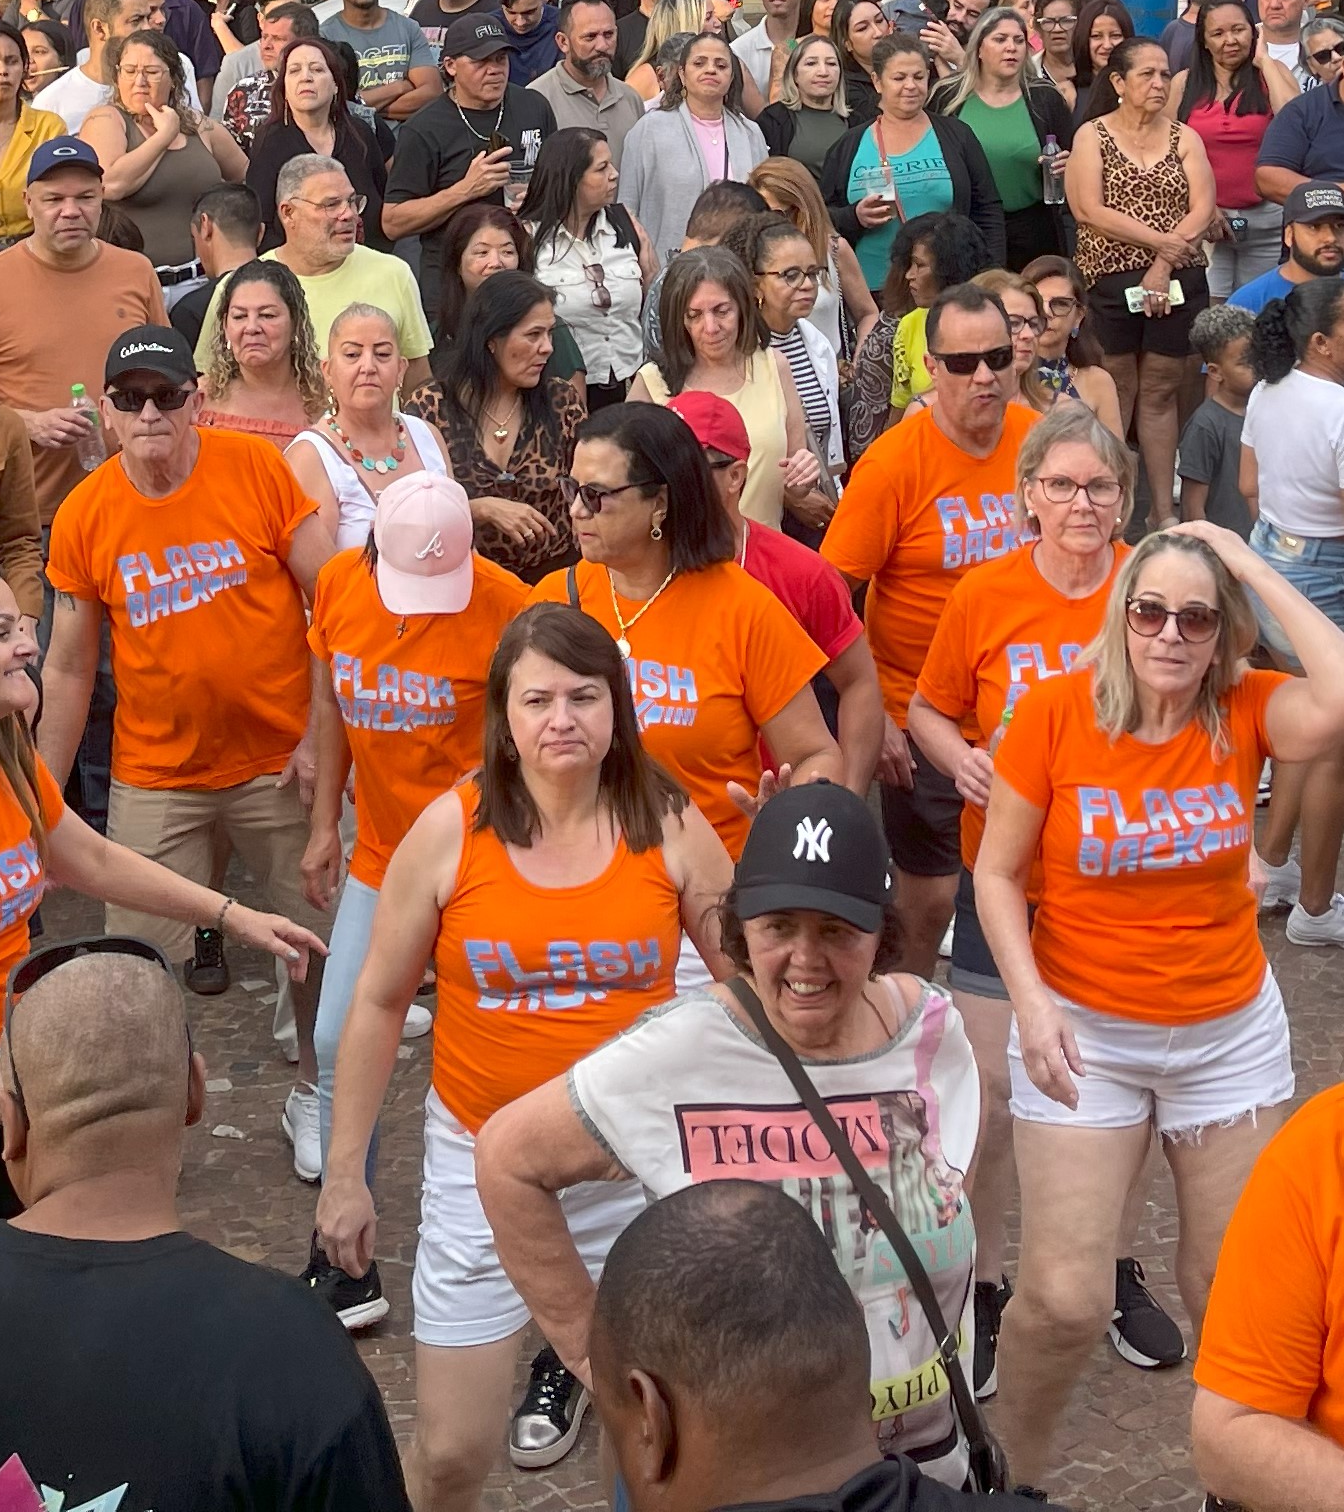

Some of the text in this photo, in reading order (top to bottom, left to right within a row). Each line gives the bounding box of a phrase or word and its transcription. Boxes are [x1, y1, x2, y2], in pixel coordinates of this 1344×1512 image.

[117, 539, 247, 594] FLASH
[125, 573, 212, 629] BACK
[333, 651, 457, 708] FLASH
[1078, 782, 1246, 836] FLASH
[792, 816, 834, 863] NY
[1078, 825, 1204, 877] BACK
[463, 939, 662, 990] FLASH
[880, 1357, 948, 1415] PHY
